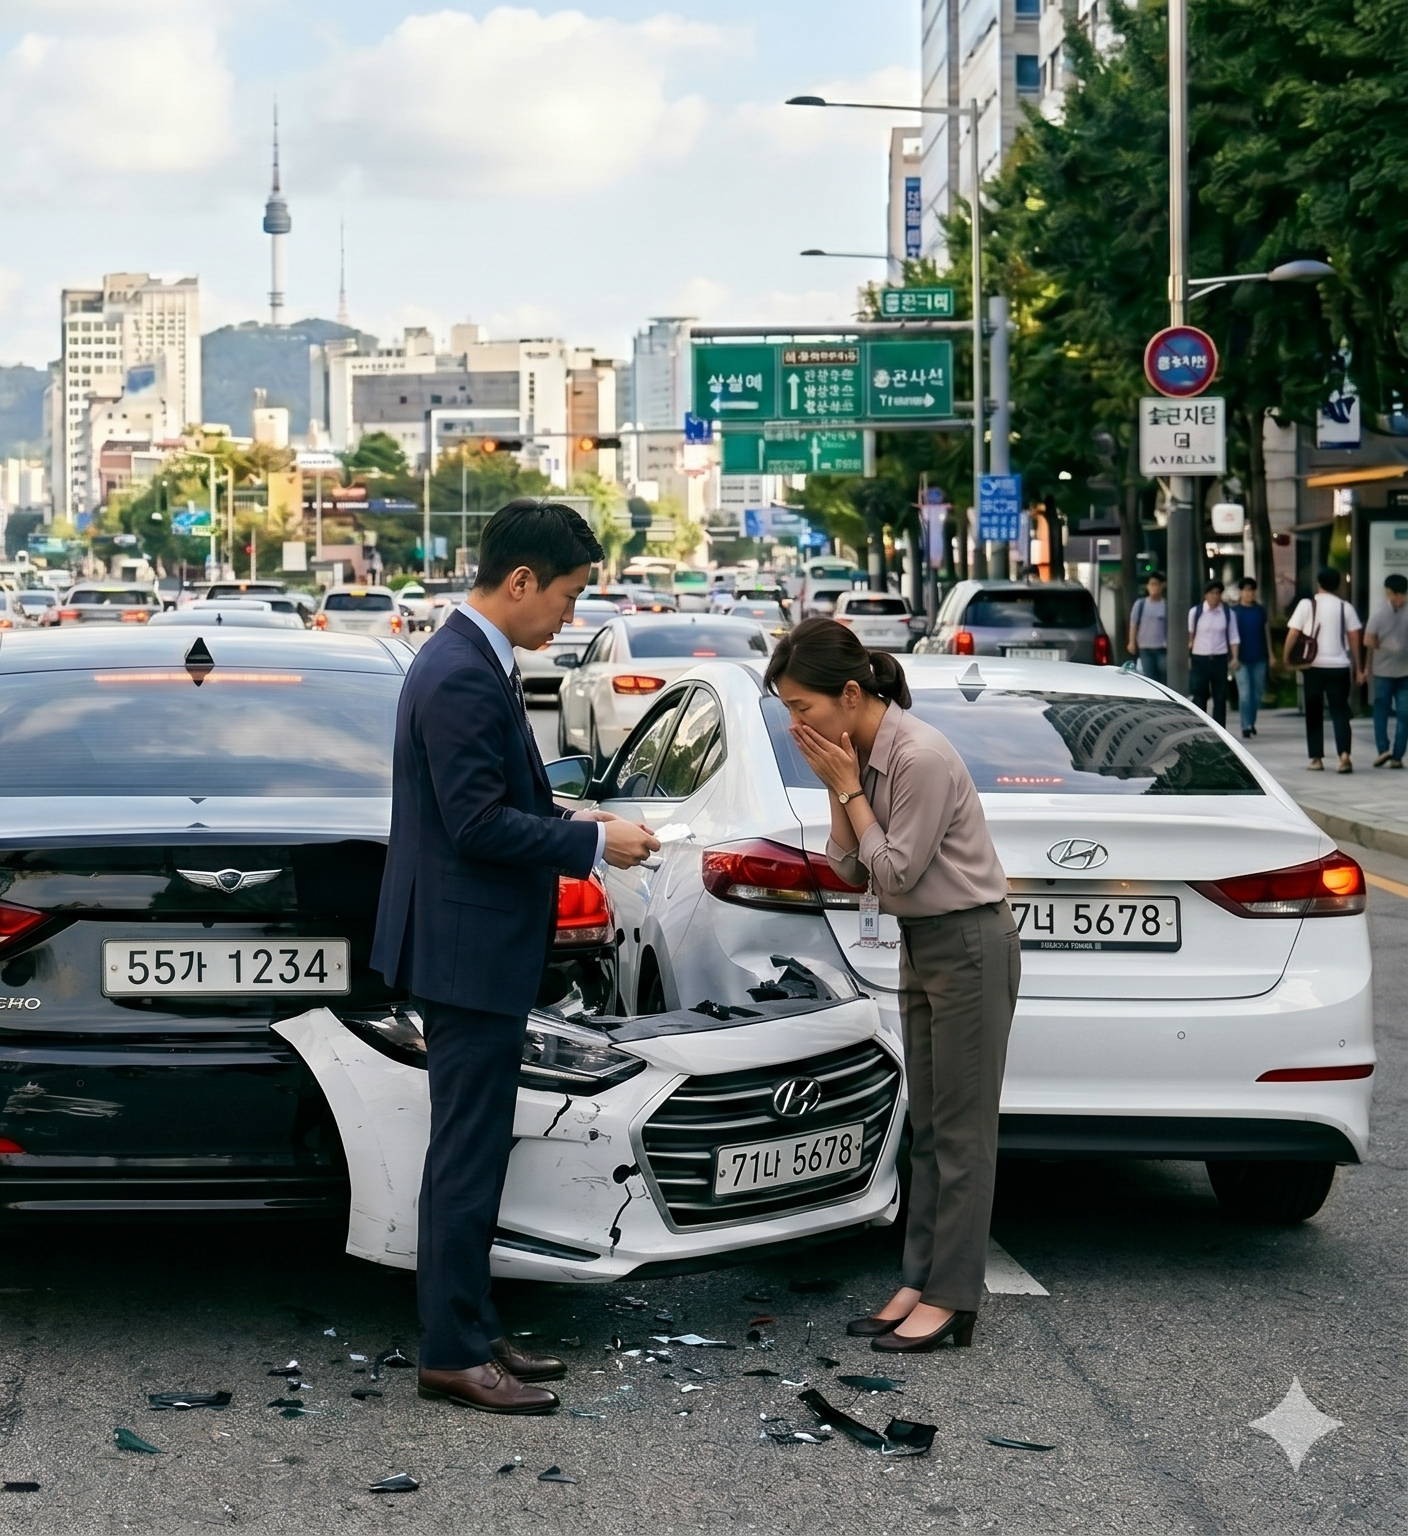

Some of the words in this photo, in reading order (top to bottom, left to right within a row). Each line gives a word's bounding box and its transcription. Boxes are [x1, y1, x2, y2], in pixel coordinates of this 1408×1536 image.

[1072, 903, 1162, 936] 5678
[127, 949, 208, 985] 55가
[228, 948, 329, 985] 1234
[731, 1149, 782, 1187] 71나
[792, 1132, 854, 1176] 5678
